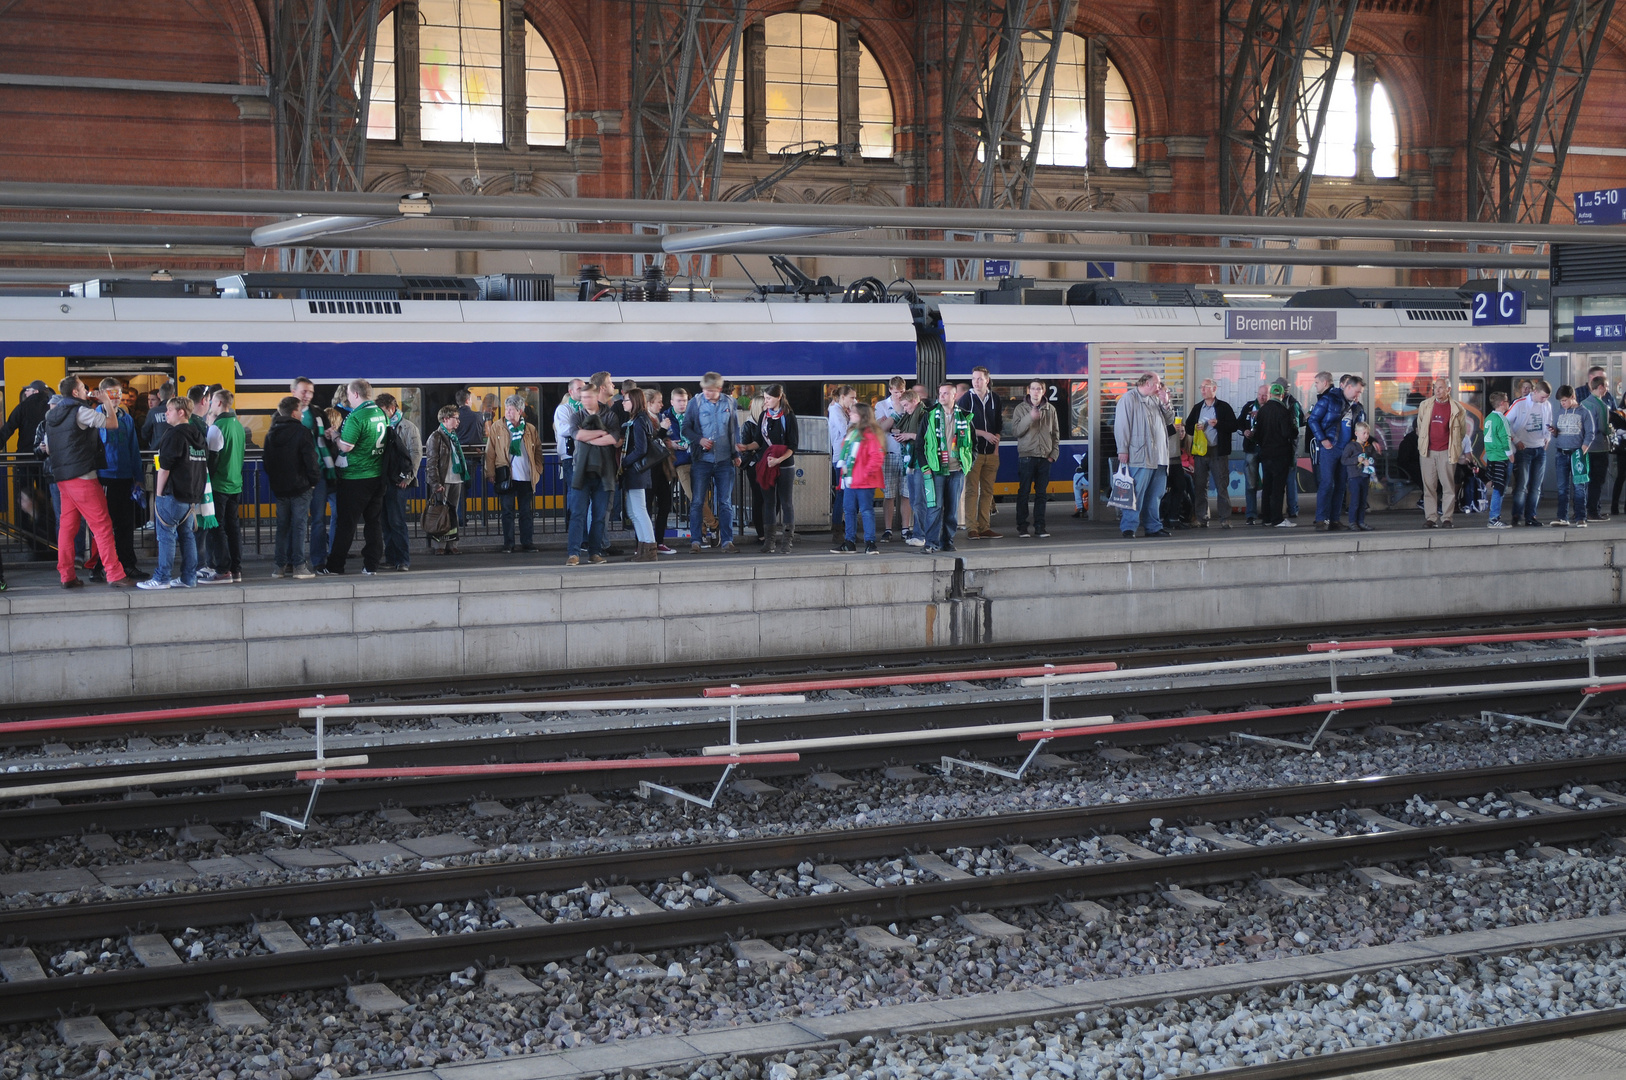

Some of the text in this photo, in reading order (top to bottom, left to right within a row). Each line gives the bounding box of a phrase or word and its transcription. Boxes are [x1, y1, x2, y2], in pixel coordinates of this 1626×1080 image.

[1578, 193, 1583, 207] 1
[1594, 189, 1618, 206] 5-10
[1475, 293, 1487, 319] 2
[1500, 291, 1514, 318] C
[1236, 315, 1313, 331] Bremen Hbf
[1048, 385, 1058, 401] 2
[375, 422, 386, 449] 2
[1483, 419, 1493, 443] 2
